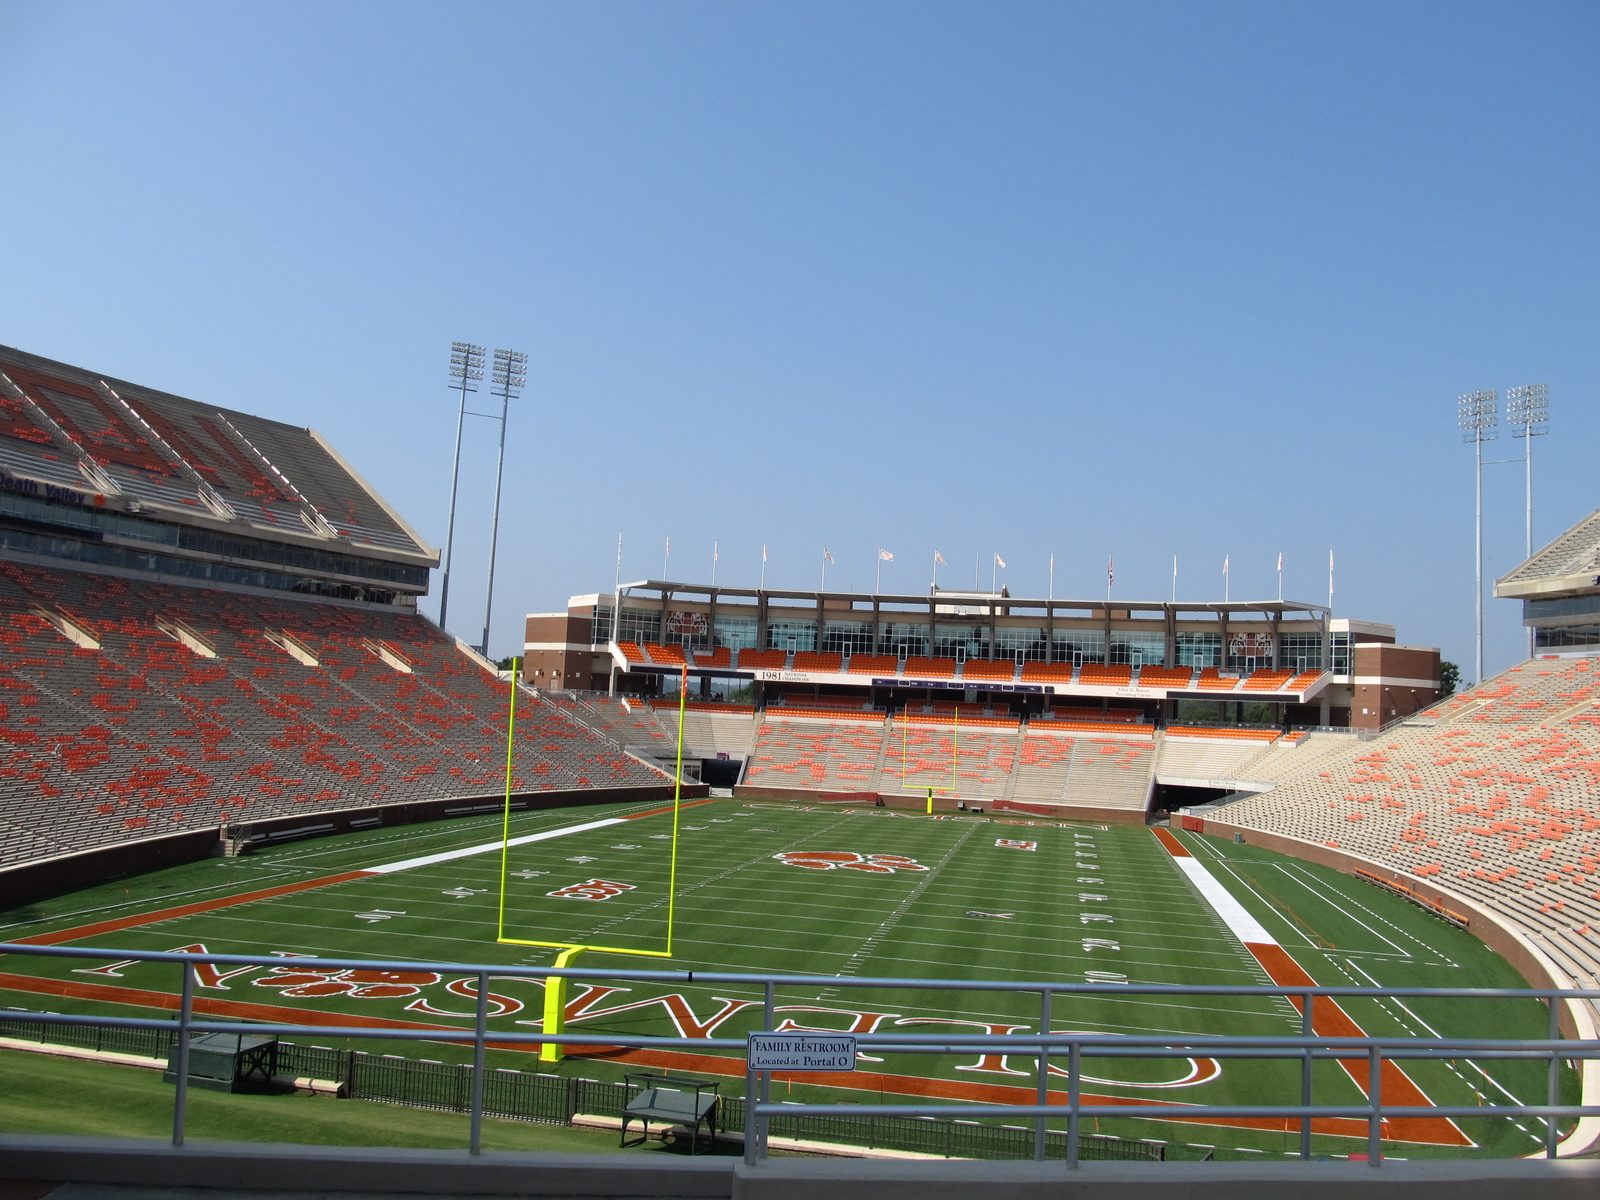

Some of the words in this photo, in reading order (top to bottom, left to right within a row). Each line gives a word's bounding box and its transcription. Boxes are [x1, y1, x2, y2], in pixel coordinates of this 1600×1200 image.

[45, 483, 85, 504] Valley
[762, 671, 781, 680] 1981
[545, 878, 638, 901] ACC
[1081, 937, 1121, 951] 20
[1083, 970, 1129, 985] 10
[755, 1041, 792, 1052] FAMILY
[793, 1042, 850, 1053] RESTROOM
[757, 1056, 790, 1065] Located
[803, 1056, 835, 1066] Portal
[838, 1056, 848, 1066] O
